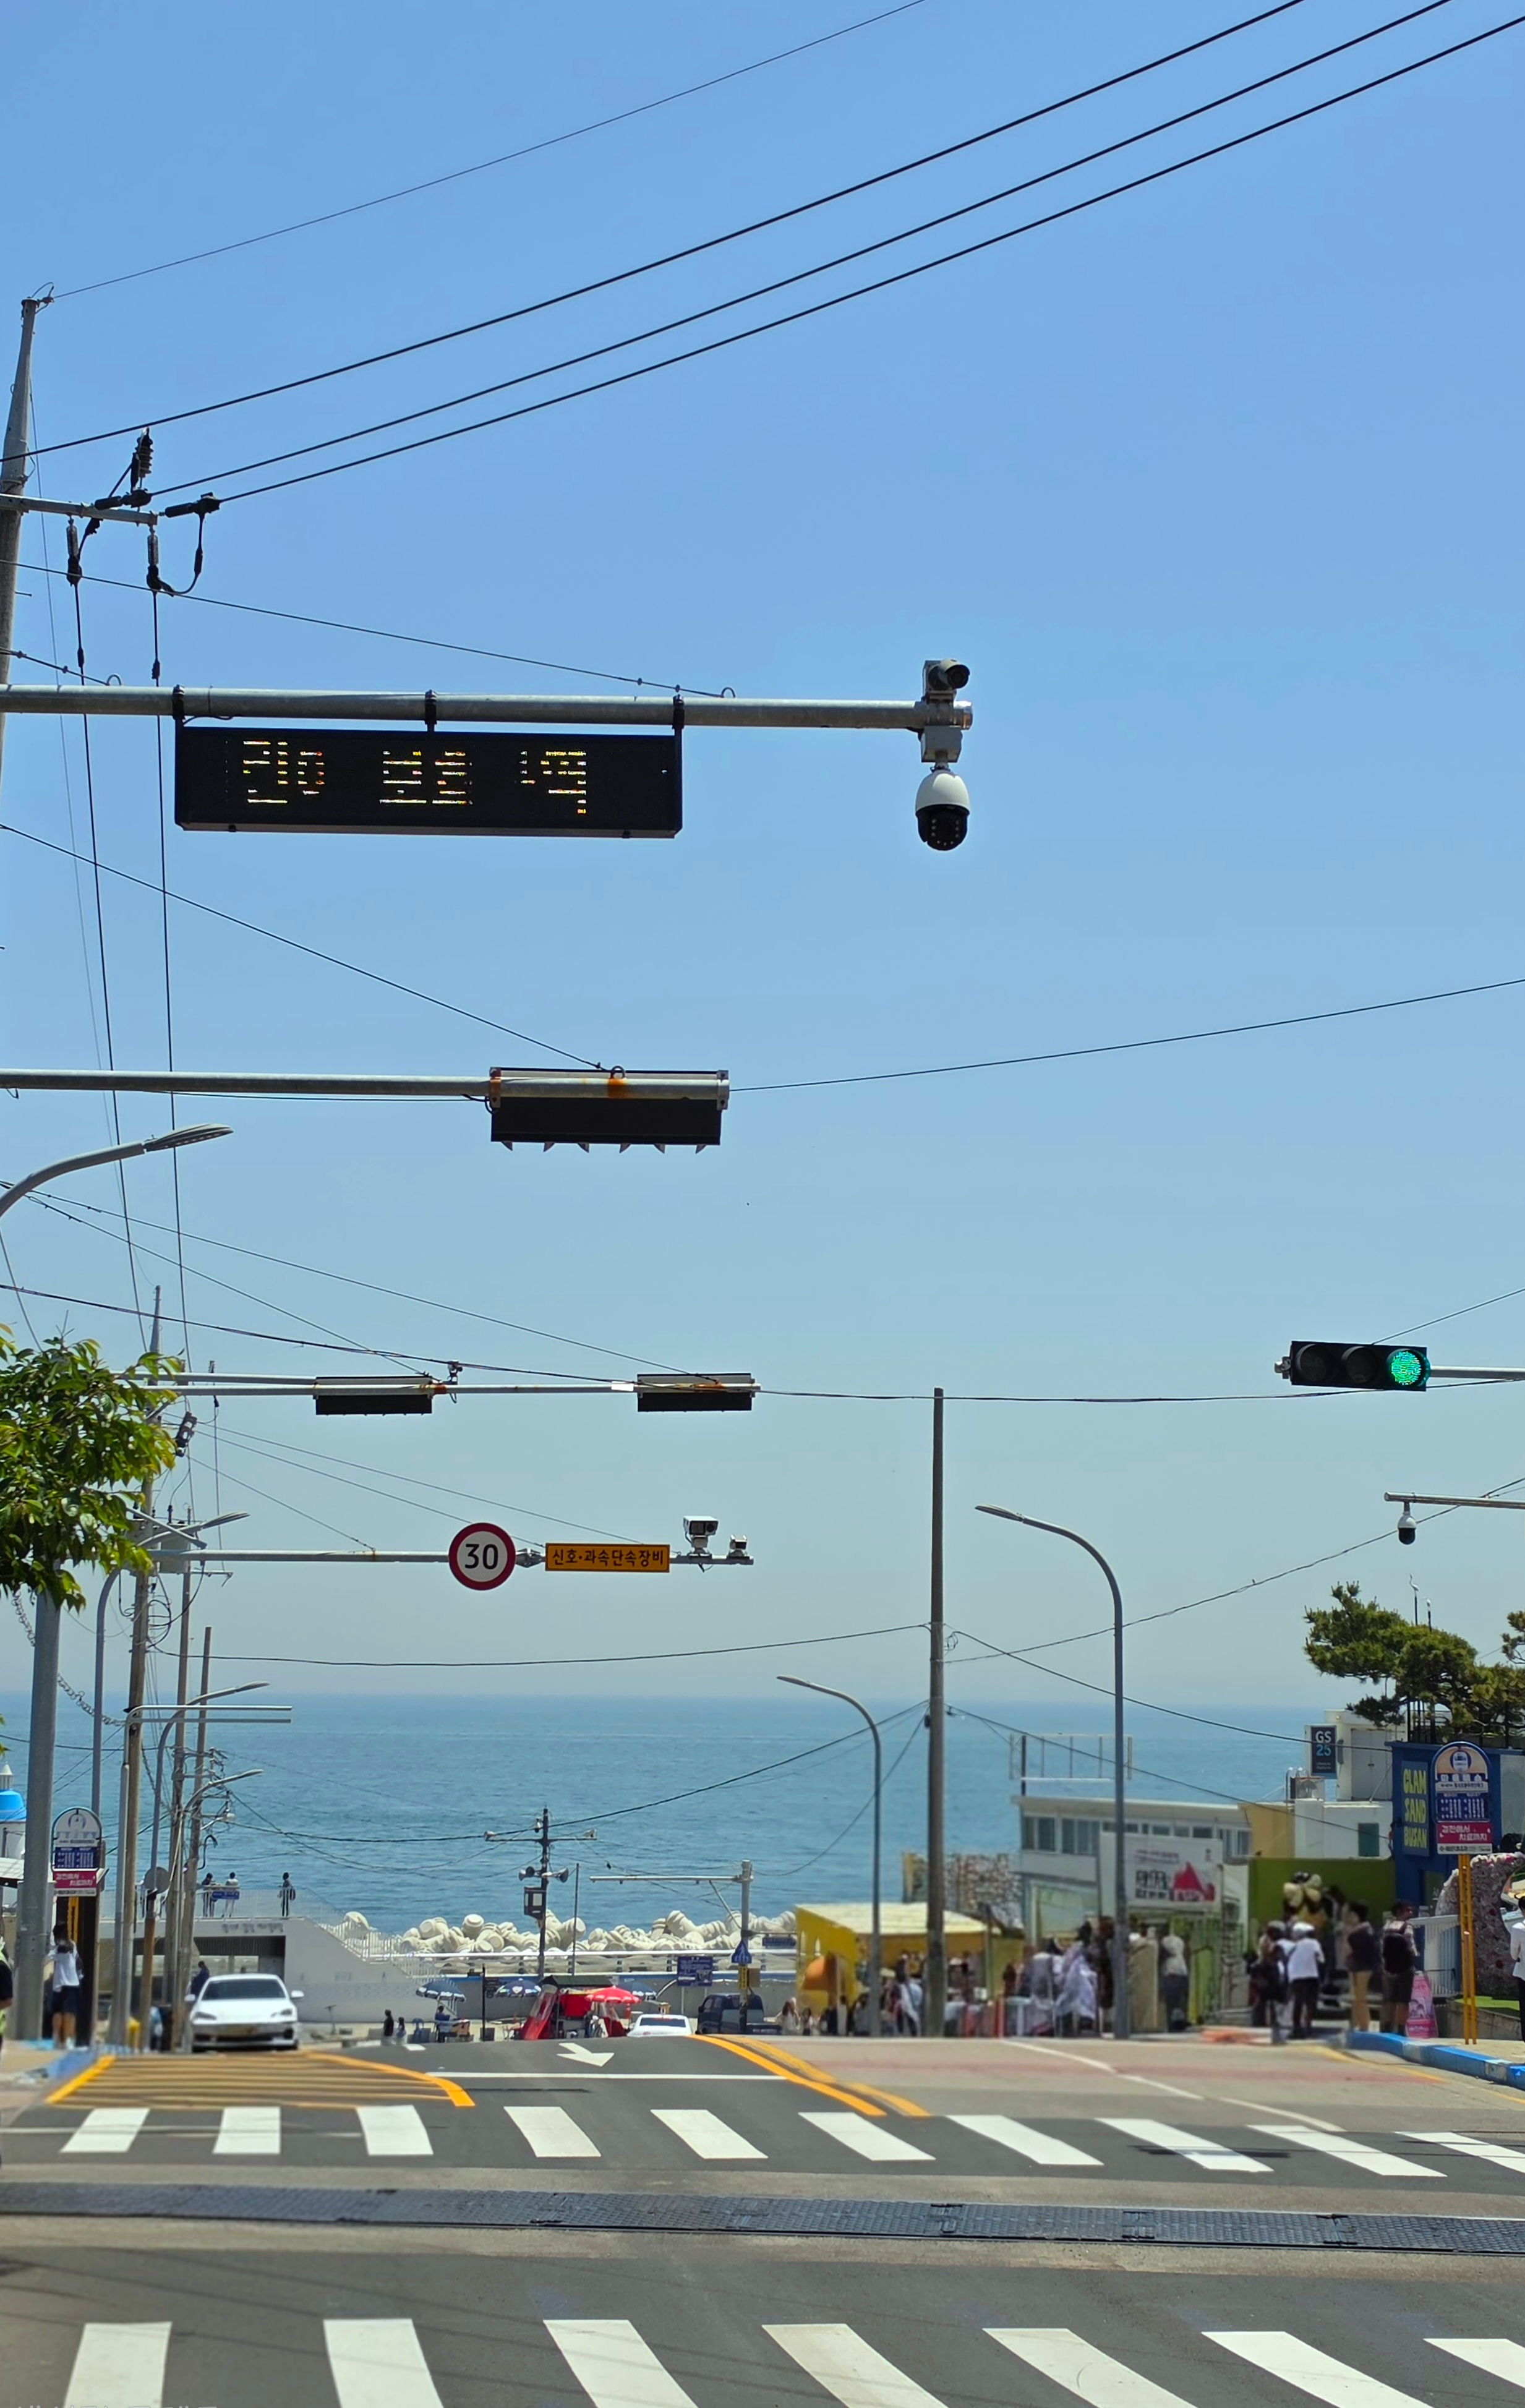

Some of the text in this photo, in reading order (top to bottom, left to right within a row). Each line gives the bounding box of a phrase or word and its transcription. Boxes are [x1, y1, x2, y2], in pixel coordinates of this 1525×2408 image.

[464, 1543, 498, 1570] 30
[1315, 1730, 1332, 1743] GS
[1316, 1744, 1332, 1756] 25
[1404, 1798, 1427, 1824] SAND
[1404, 1825, 1427, 1849] BUSAN
